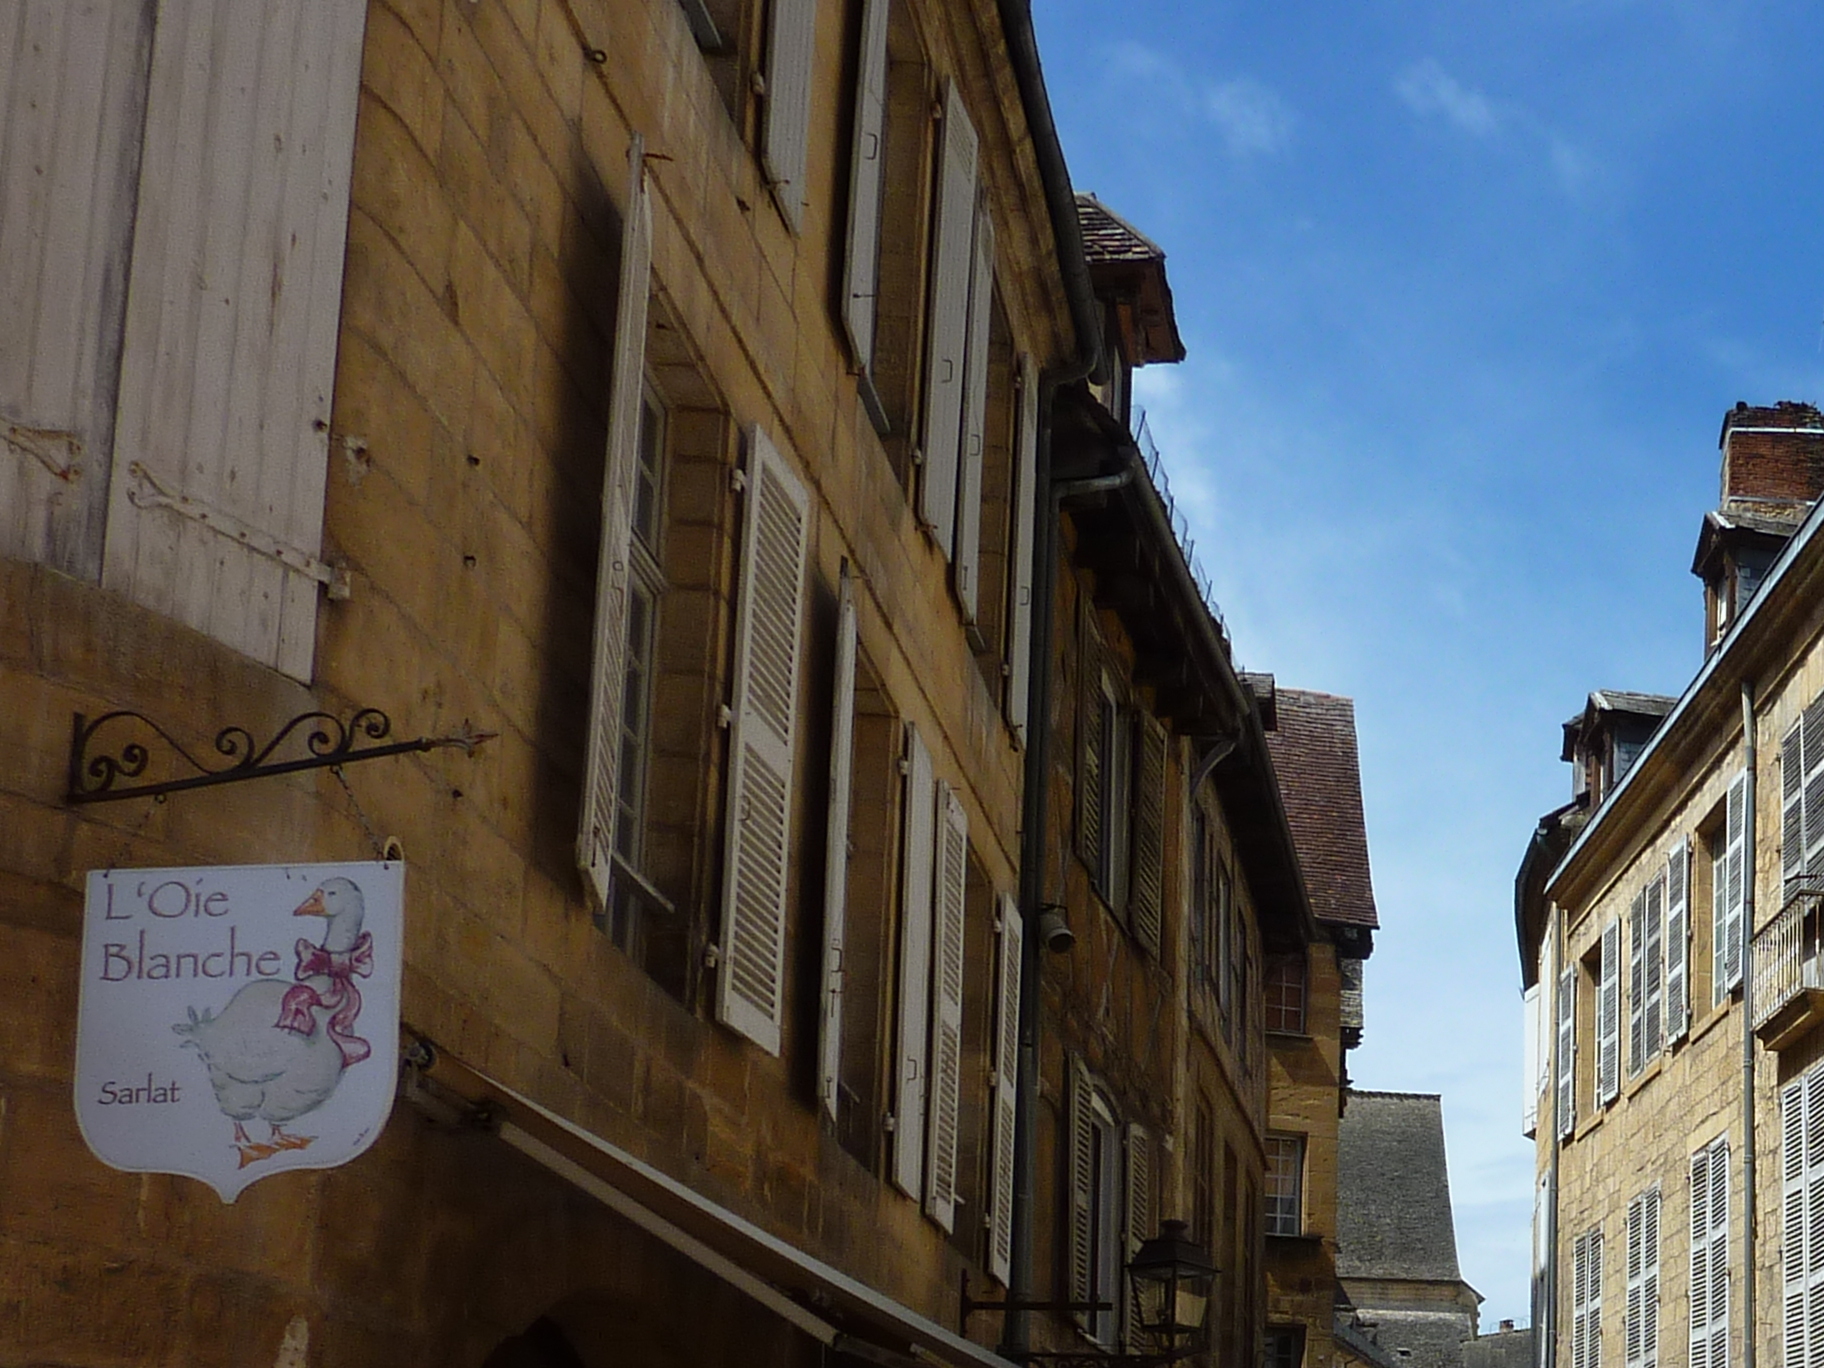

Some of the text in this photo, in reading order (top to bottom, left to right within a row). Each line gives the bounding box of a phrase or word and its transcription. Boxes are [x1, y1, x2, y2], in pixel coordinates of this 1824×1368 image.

[105, 878, 229, 920] L'Oie
[100, 926, 281, 982] Blanche
[97, 1072, 180, 1105] Sarlat
